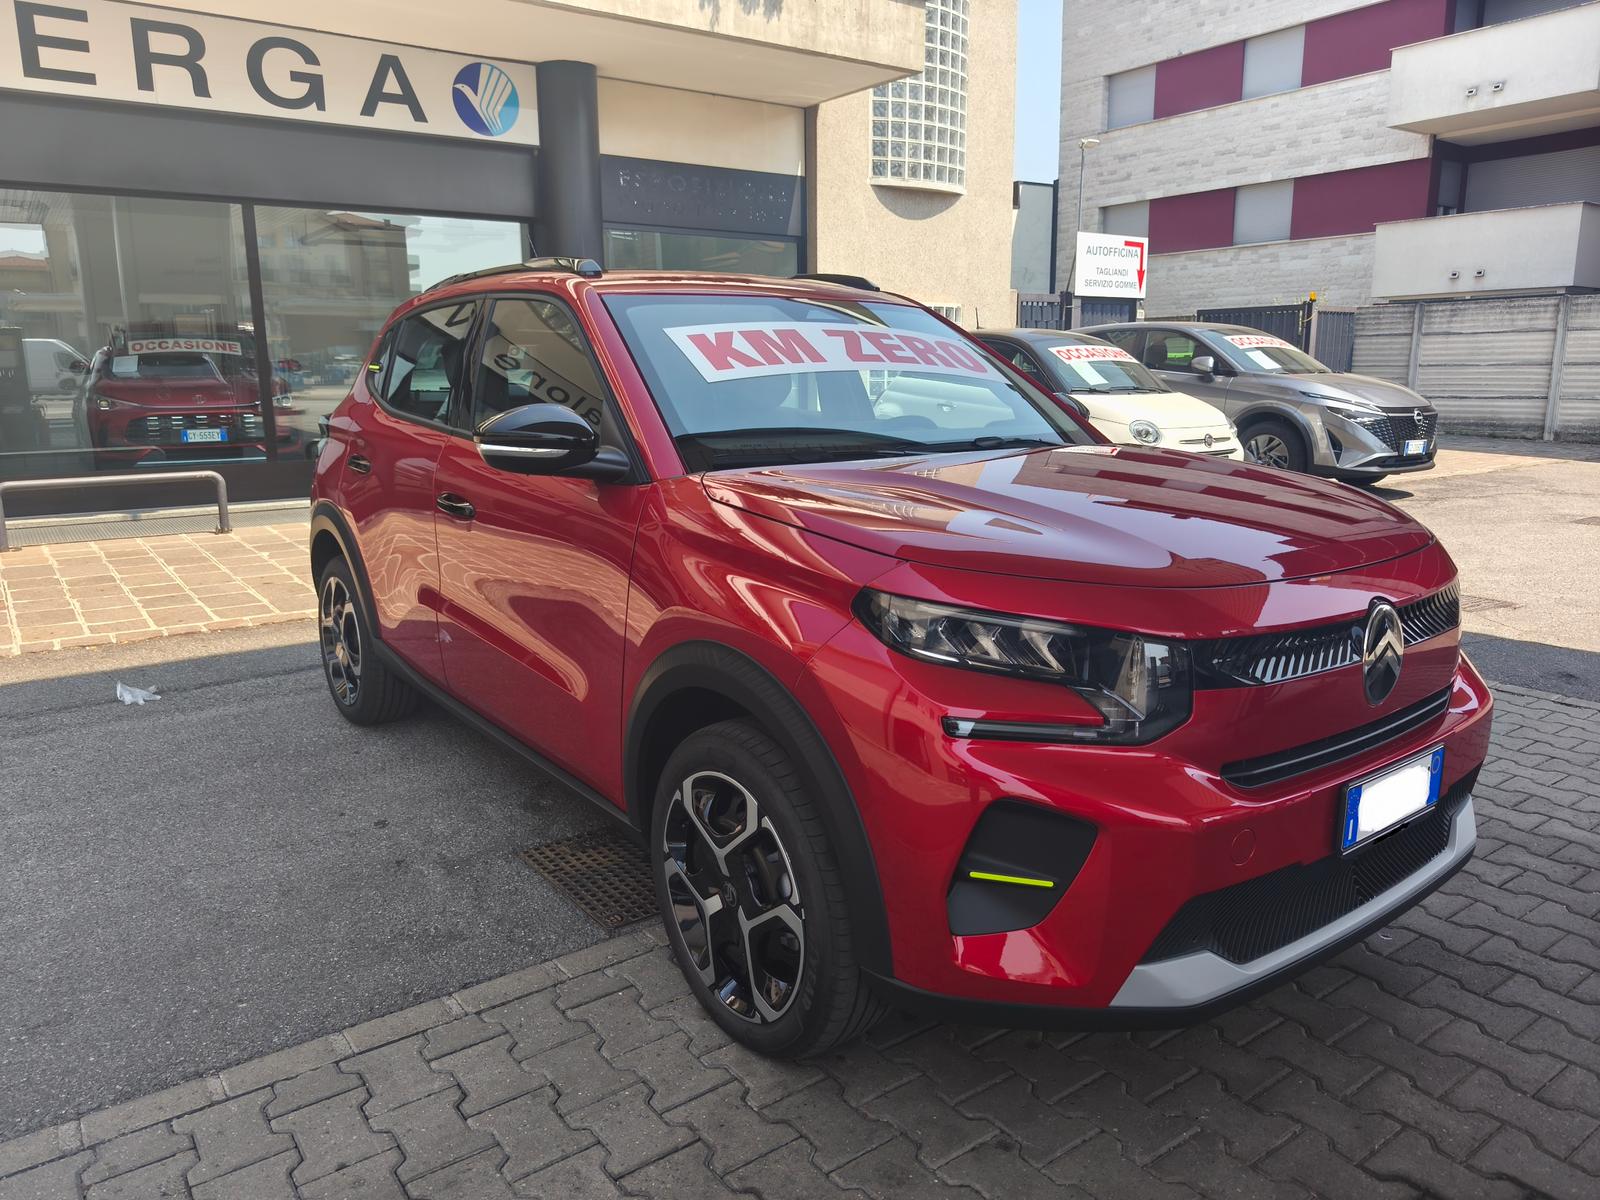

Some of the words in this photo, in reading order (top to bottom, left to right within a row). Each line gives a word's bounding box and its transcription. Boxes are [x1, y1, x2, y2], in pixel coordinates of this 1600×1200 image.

[13, 0, 430, 124] ERGA
[1086, 245, 1139, 259] AUTOFFICINA
[1096, 267, 1129, 277] TAGLIANDI
[1084, 279, 1113, 288] SERVIZIO
[1114, 280, 1137, 290] GOMME
[131, 340, 240, 353] OCCASIONE
[687, 329, 827, 371] KM
[822, 329, 988, 374] ZERO
